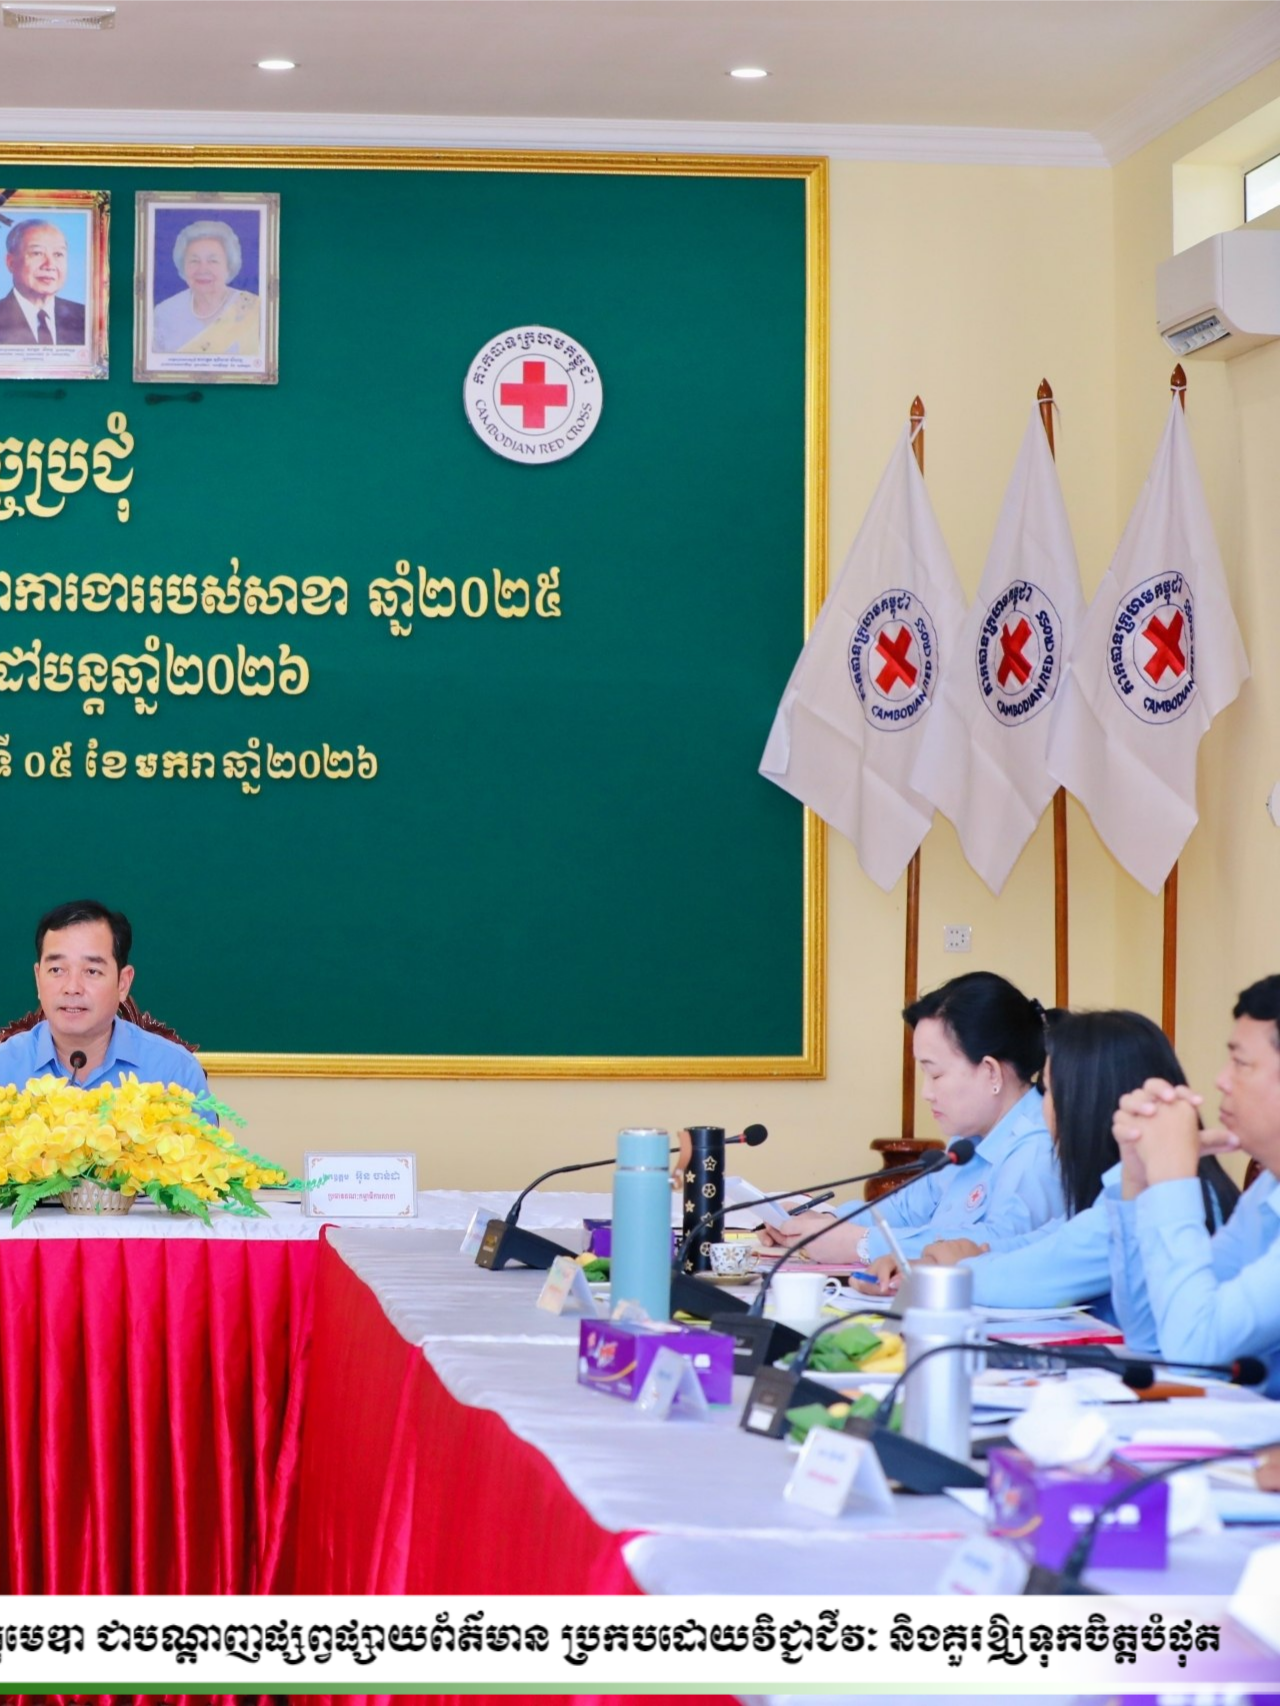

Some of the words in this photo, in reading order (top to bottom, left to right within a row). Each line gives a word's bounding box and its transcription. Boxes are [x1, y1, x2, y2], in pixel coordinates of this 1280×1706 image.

[475, 399, 536, 455] CAMBODIAN
[539, 438, 565, 454] RED
[565, 402, 593, 441] CROSS
[369, 559, 562, 636] ឆ្នាំ២០២៥
[914, 617, 932, 658] CROSS
[1035, 610, 1055, 653] CROSS
[921, 660, 932, 690] RED
[1038, 654, 1054, 686] RED
[871, 690, 927, 721] CAMBODIAN
[996, 683, 1046, 717] CAMBODIAN
[1143, 678, 1195, 714] CAMBODIAN
